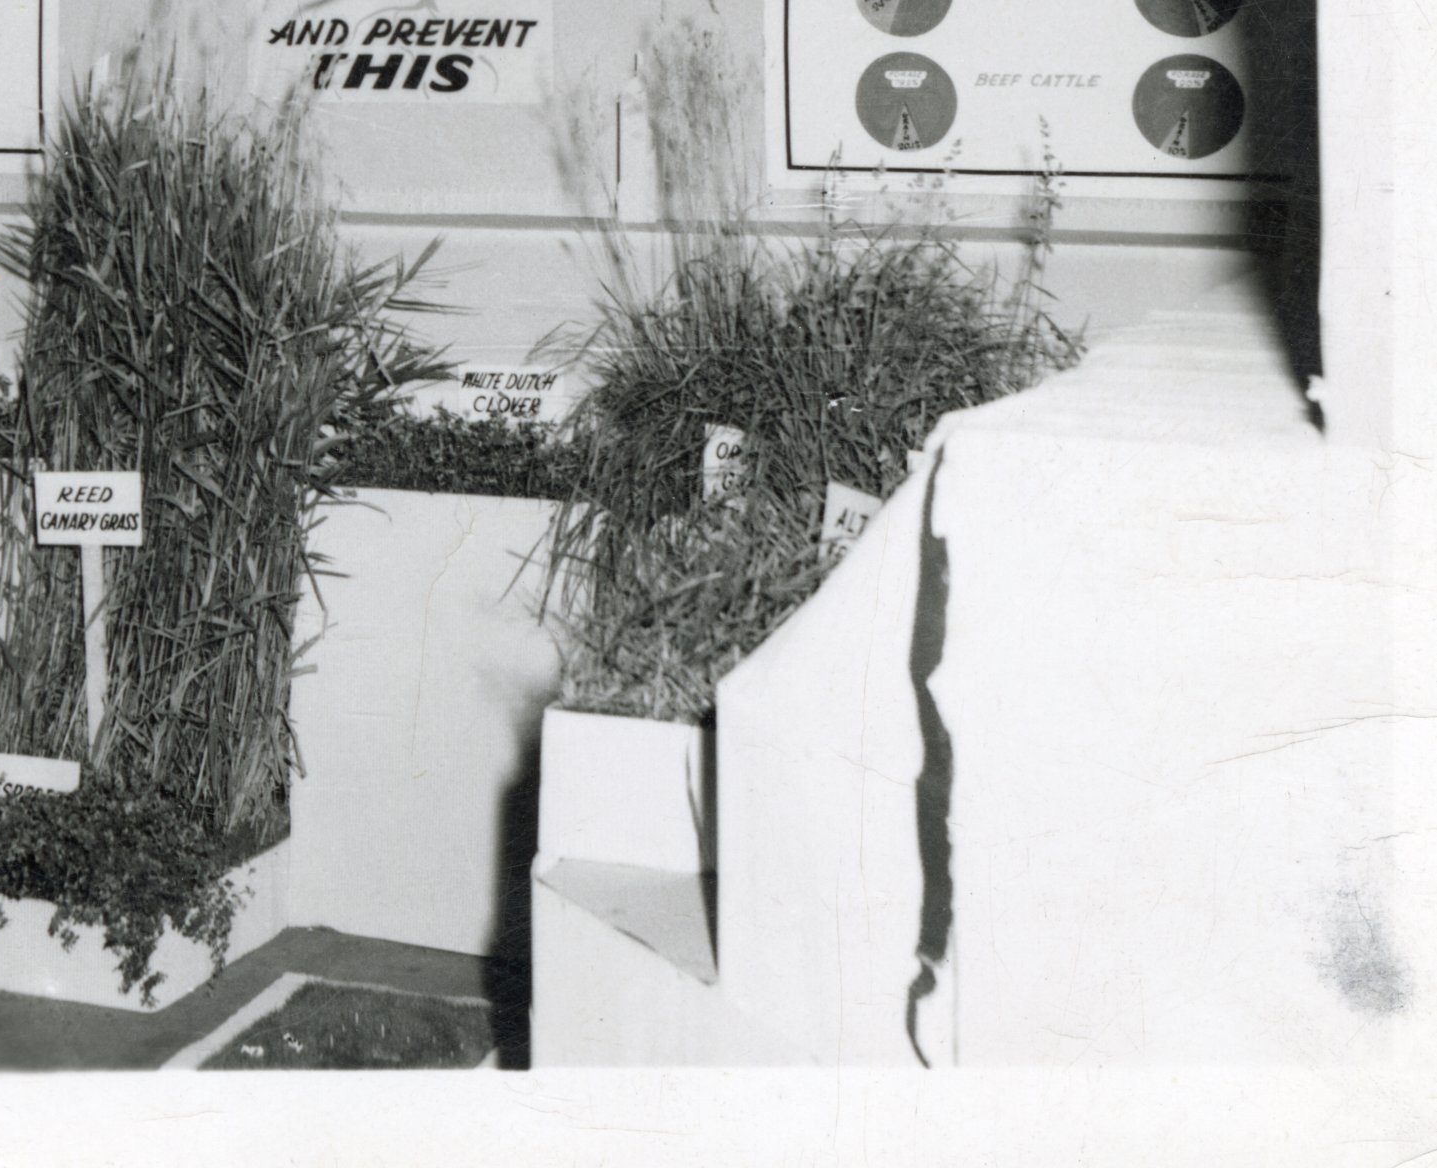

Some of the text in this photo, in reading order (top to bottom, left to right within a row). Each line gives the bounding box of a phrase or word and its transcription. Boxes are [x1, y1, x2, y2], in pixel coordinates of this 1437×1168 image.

[267, 18, 539, 47] AND PREVENT
[312, 54, 474, 93] THIS
[975, 73, 1102, 88] BEEF CATTLE
[508, 372, 557, 392] DUTCH
[472, 395, 542, 414] CLOVER
[56, 486, 113, 504] REED
[40, 512, 140, 532] CANARY GRASS
